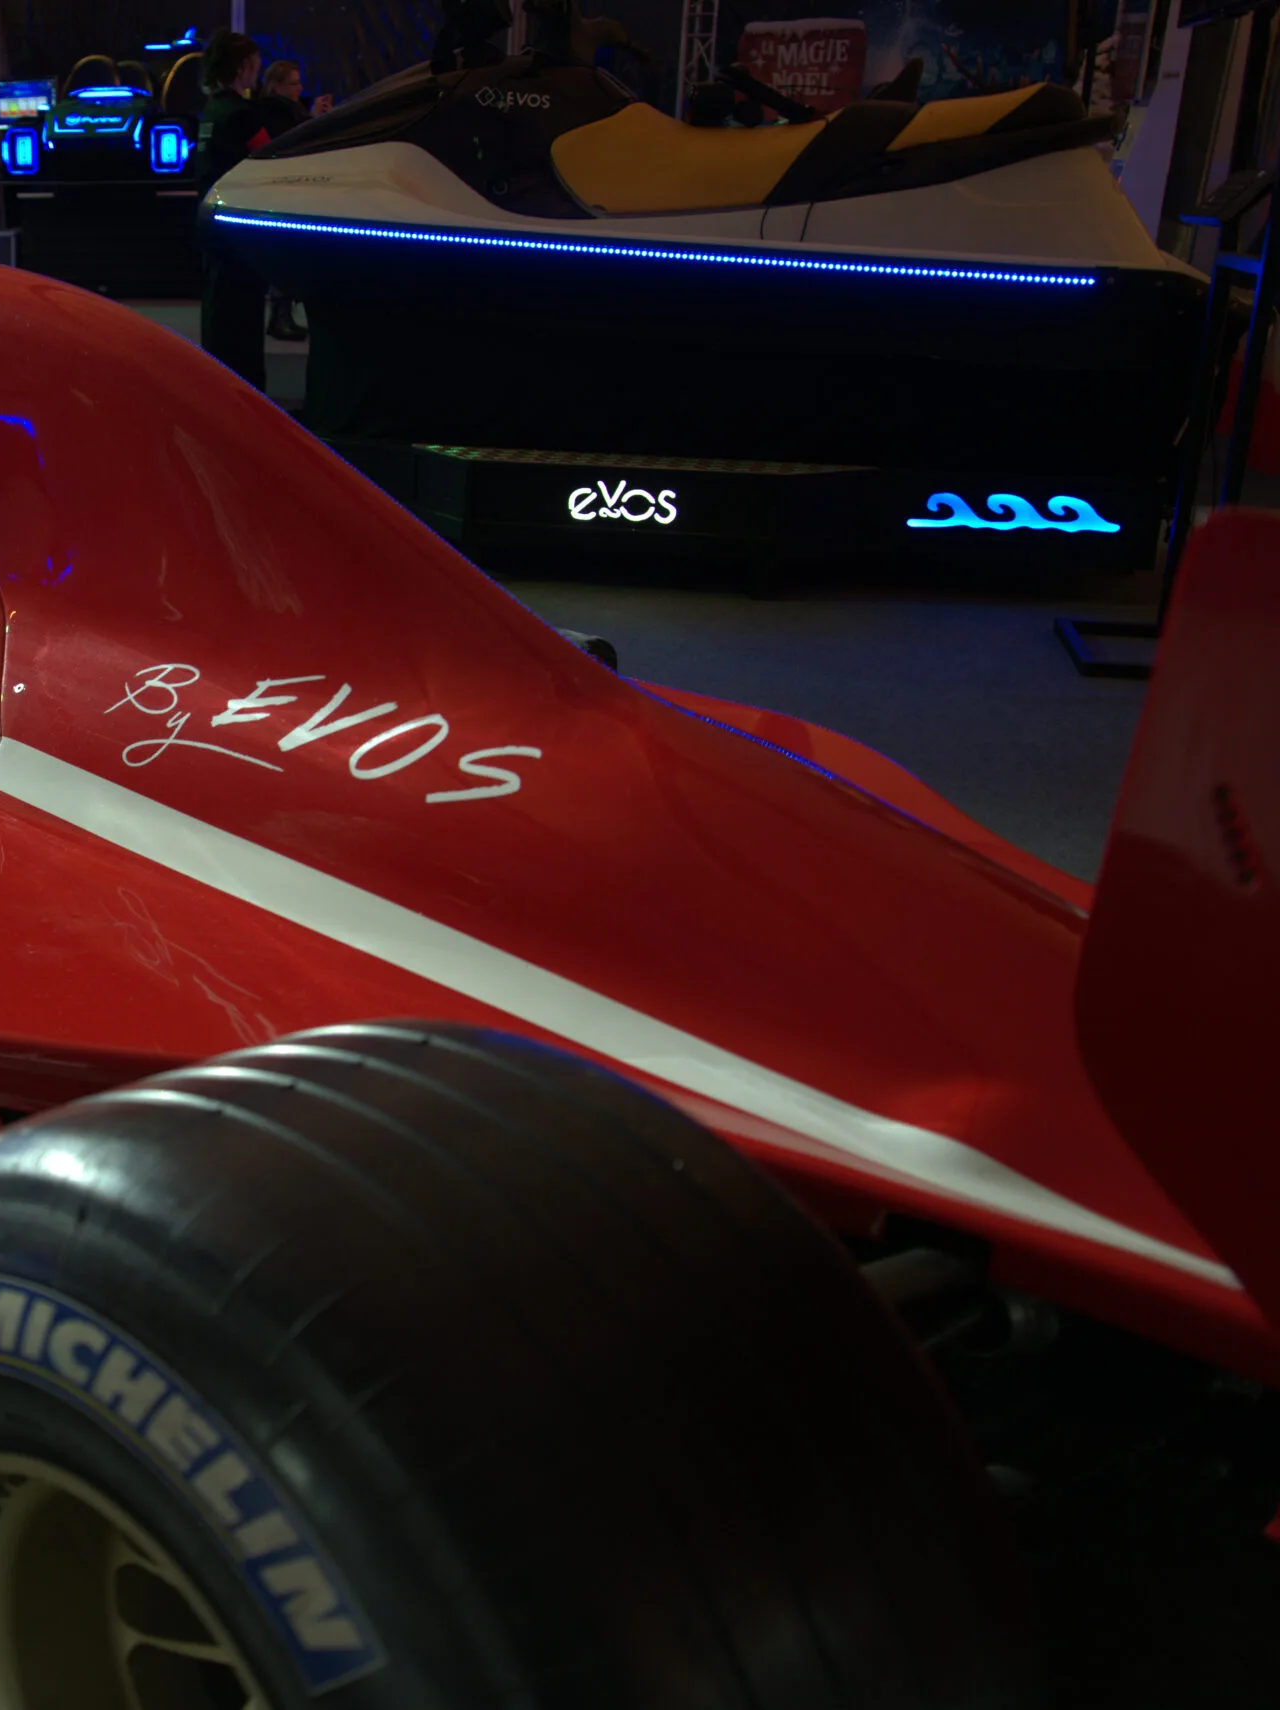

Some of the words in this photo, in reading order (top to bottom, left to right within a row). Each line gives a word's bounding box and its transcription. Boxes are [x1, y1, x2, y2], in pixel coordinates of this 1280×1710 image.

[776, 37, 851, 69] MAGIE
[506, 90, 552, 109] EVOS
[104, 663, 285, 772] By
[211, 674, 543, 804] EVOS
